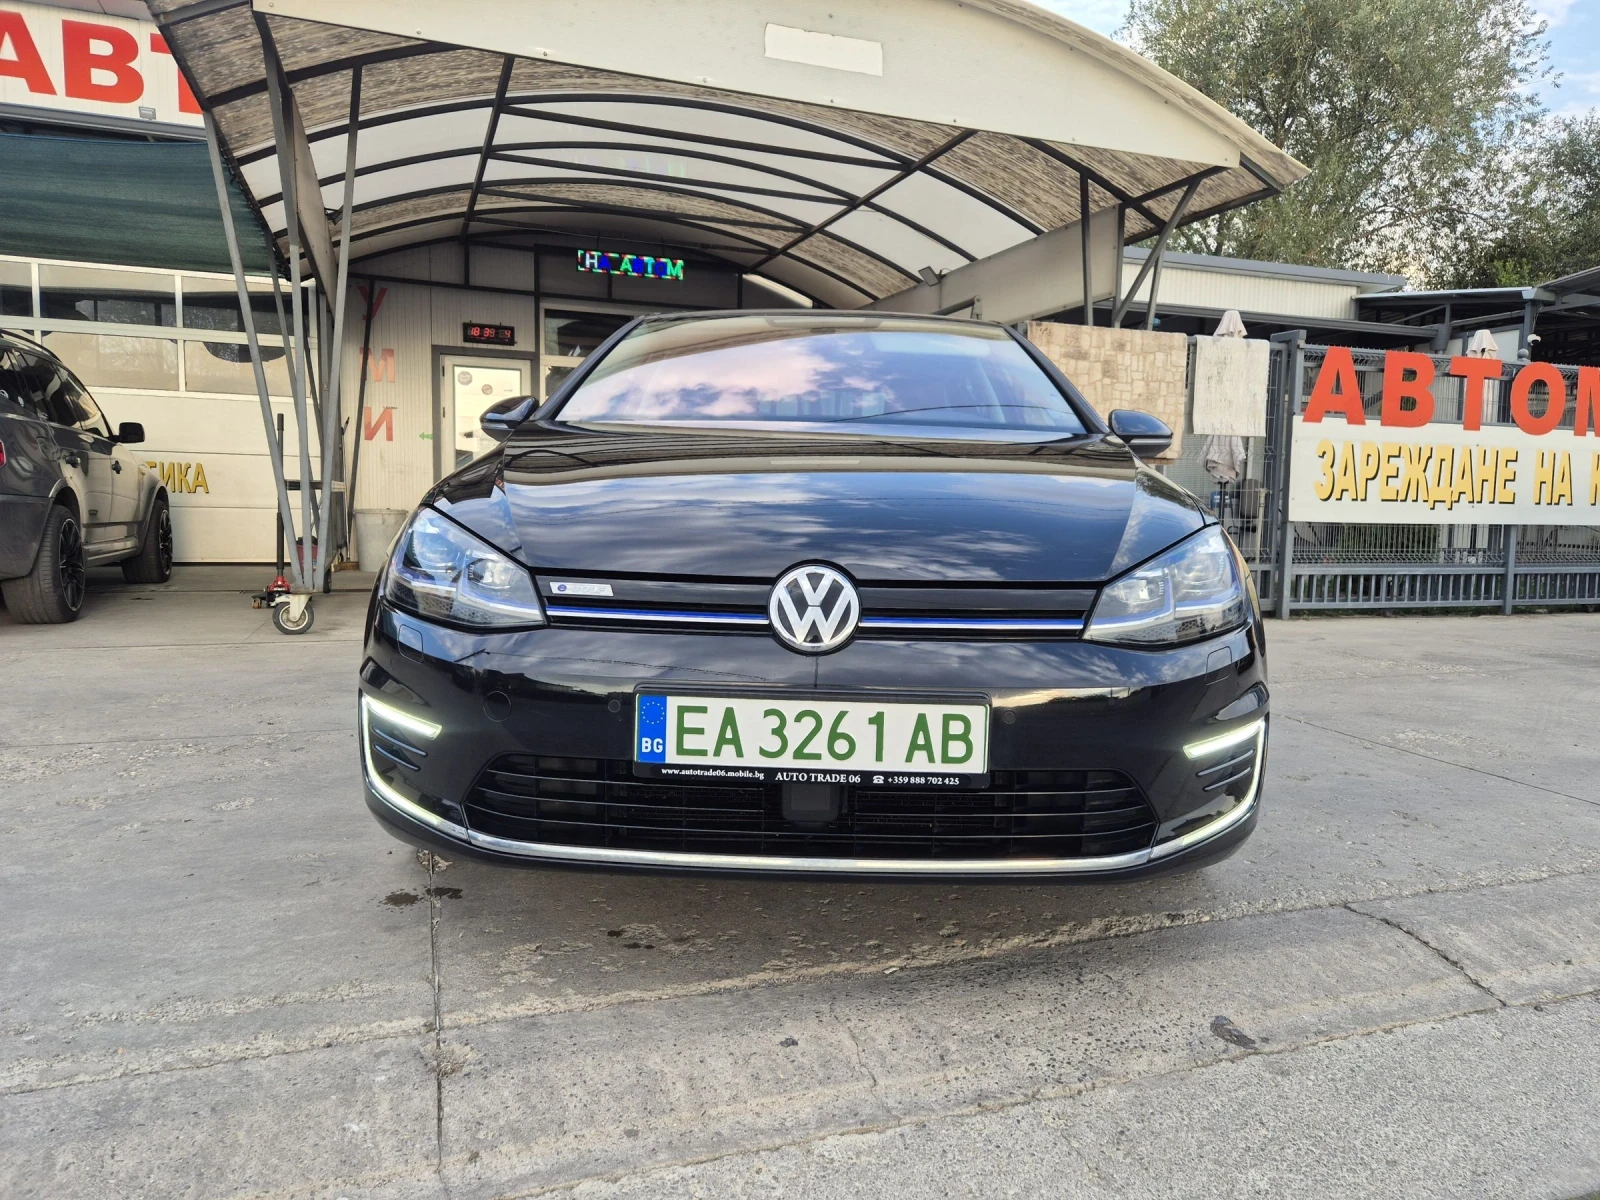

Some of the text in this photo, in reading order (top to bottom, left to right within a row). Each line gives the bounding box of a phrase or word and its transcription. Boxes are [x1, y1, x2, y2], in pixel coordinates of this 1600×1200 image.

[1313, 439, 1518, 511] ЗАРЕЖДАНЕ
[1533, 448, 1573, 506] НА
[641, 738, 664, 754] BG
[676, 705, 974, 765] EA 3261 AB
[661, 767, 960, 786] www.autotrade06.mobile.bg AUTO TRADE 06 +359 888 702 425
